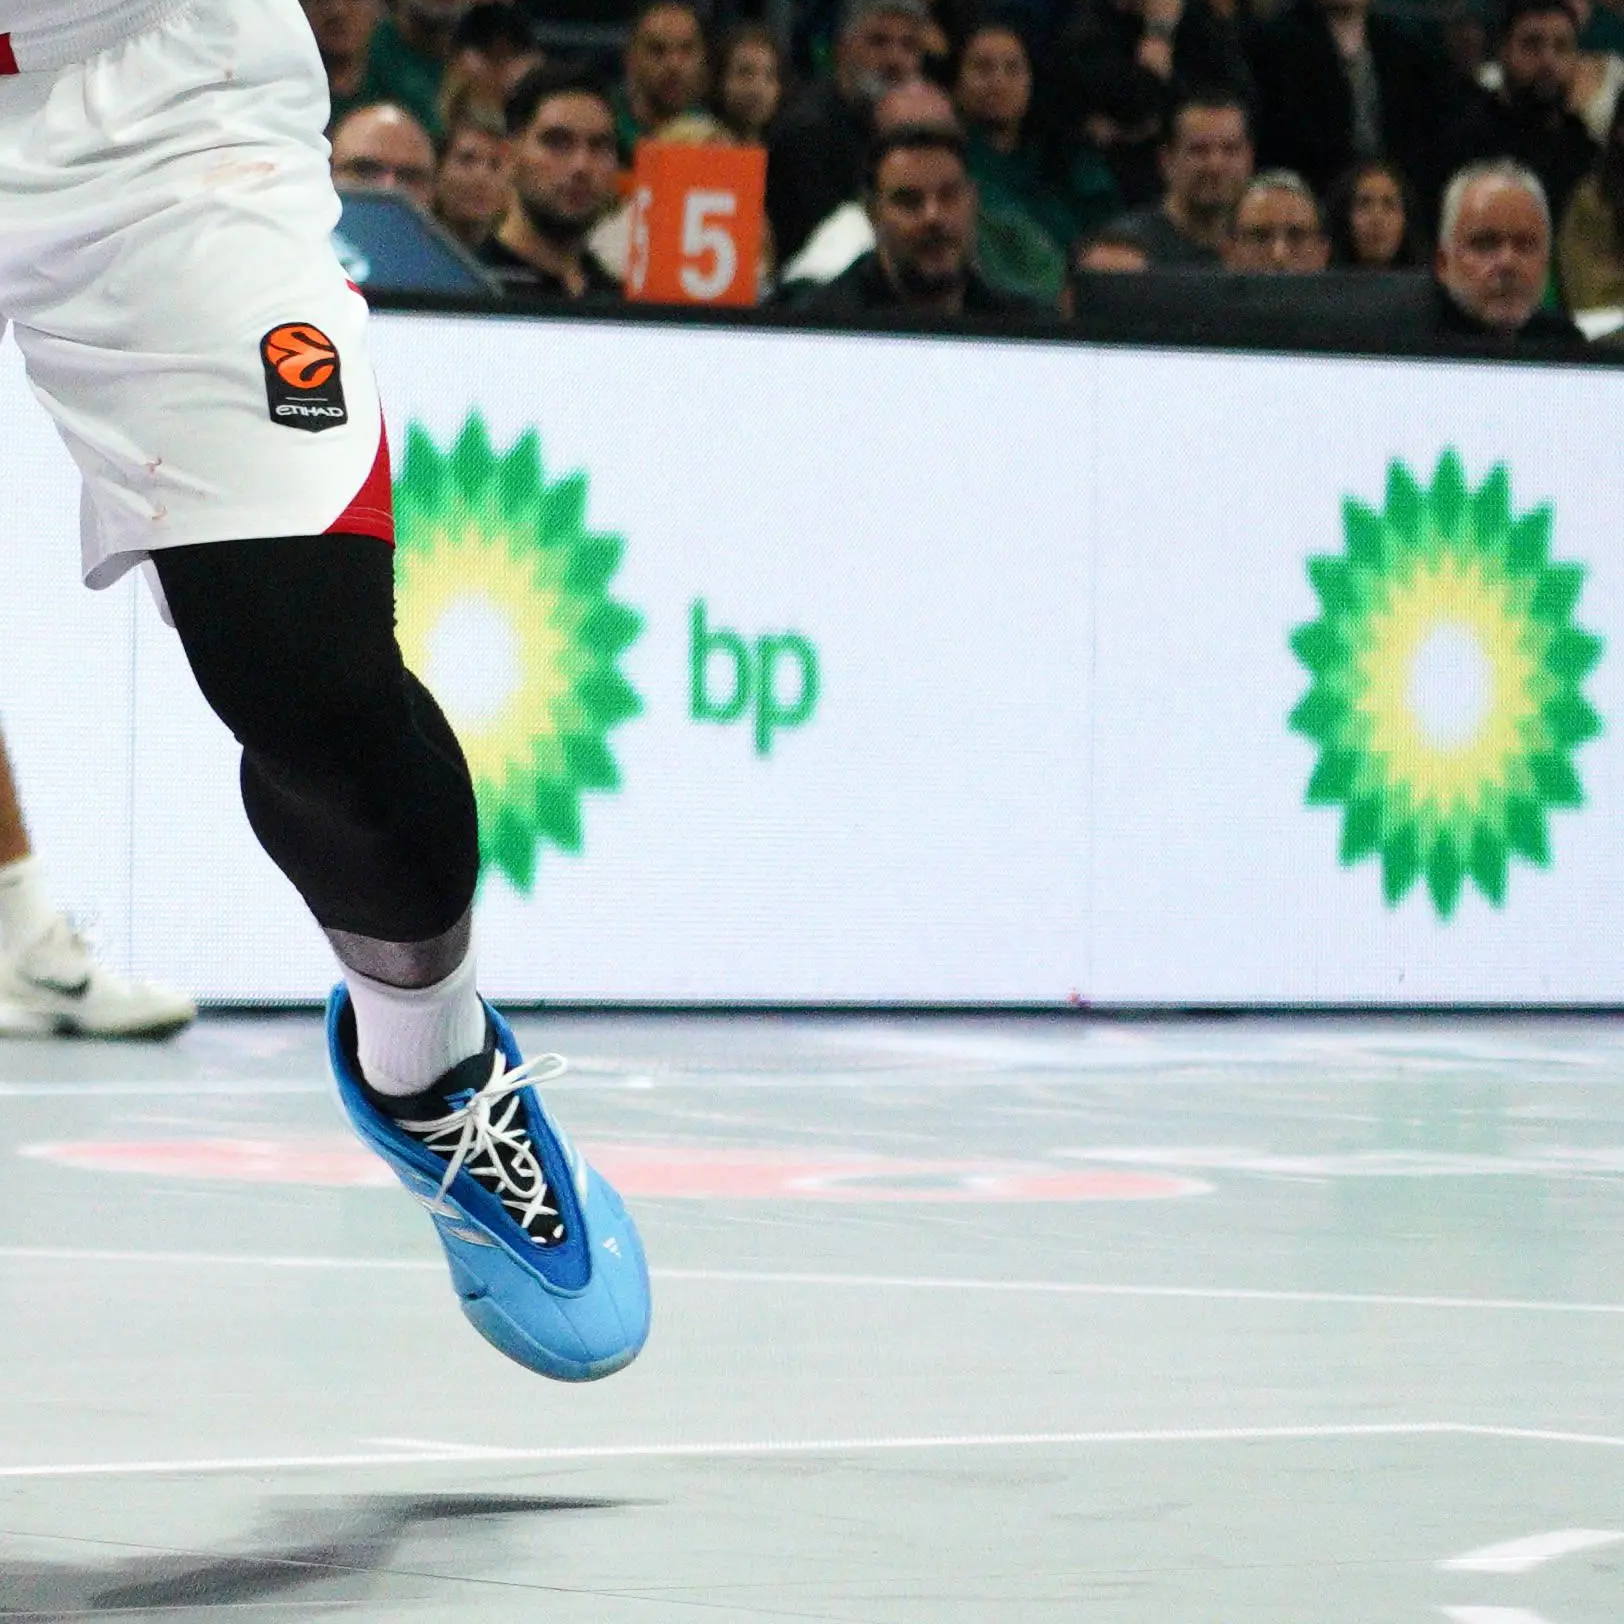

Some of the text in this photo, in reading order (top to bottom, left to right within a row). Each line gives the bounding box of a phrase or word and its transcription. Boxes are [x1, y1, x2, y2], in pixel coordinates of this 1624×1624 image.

[678, 190, 738, 301] 5
[275, 404, 345, 418] ETIHAD
[688, 598, 822, 757] bp
